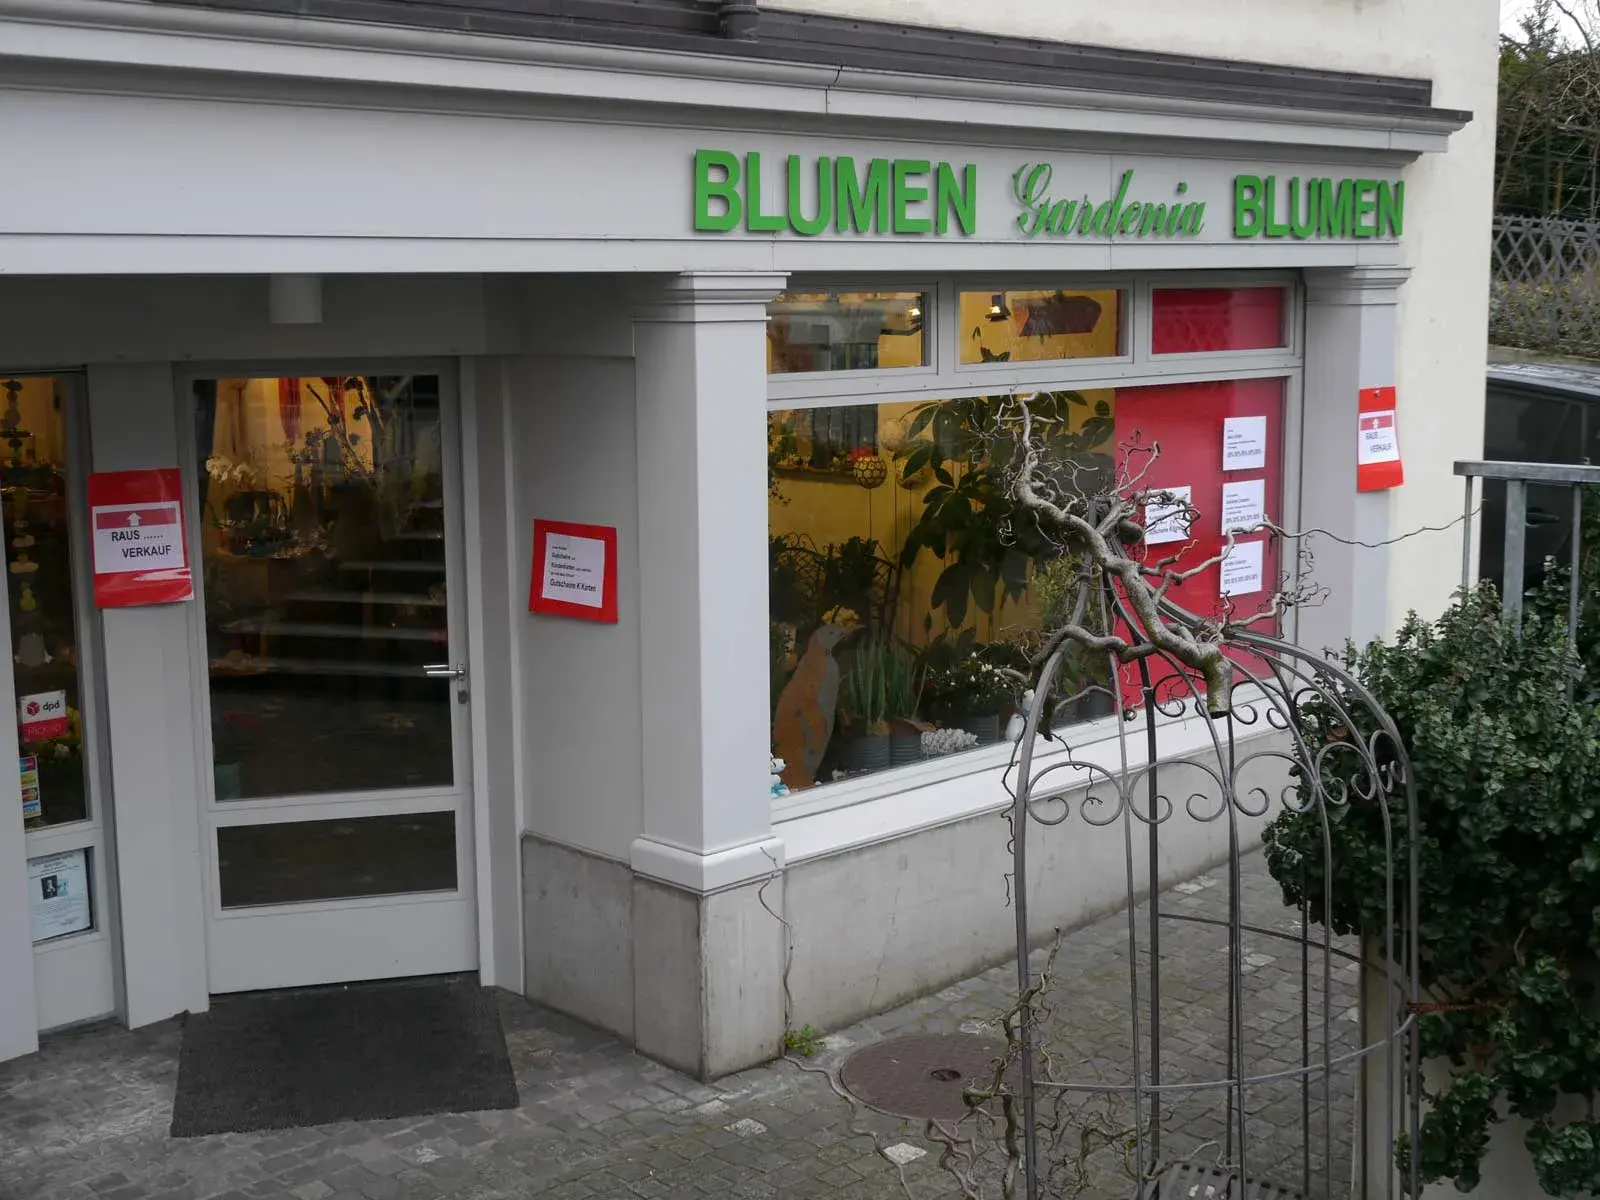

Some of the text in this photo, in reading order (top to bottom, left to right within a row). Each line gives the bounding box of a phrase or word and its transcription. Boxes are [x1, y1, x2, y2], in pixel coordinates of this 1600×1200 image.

[693, 149, 1405, 238] BLUMEN Gardenia BLUMEN
[111, 530, 140, 542] RAUS
[121, 544, 172, 559] VERKAUF
[42, 700, 60, 713] dpd
